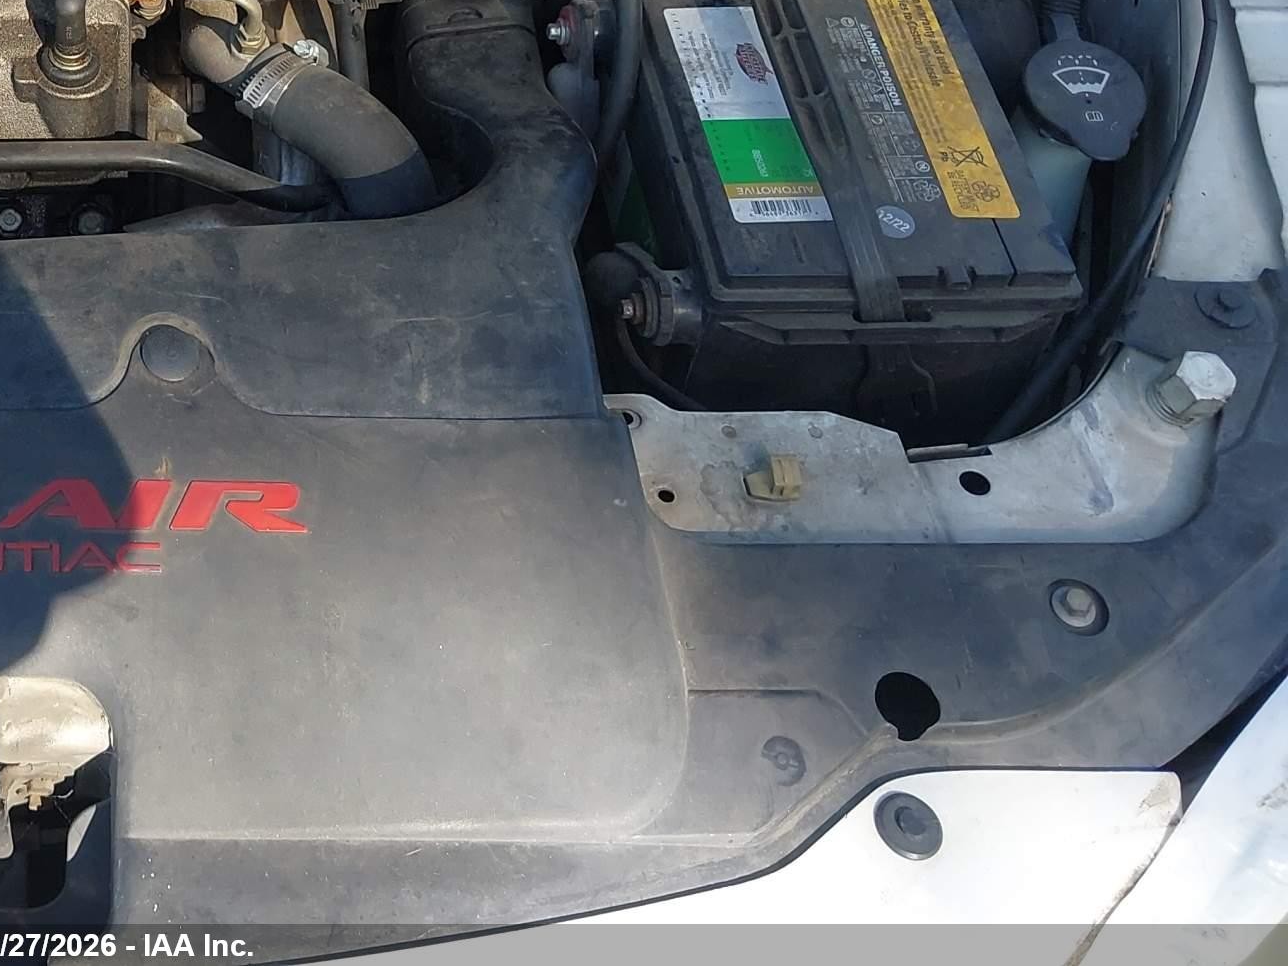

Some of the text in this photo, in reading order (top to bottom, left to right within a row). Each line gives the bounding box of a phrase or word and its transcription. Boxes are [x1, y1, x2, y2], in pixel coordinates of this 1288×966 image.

[864, 29, 902, 106] DANGER POISON
[907, 21, 922, 45] Costco
[916, 46, 941, 87] Wholesale
[916, 5, 935, 38] warranty
[930, 40, 944, 55] and
[937, 55, 955, 75] used
[735, 185, 814, 196] AUTOMOTIVE
[0, 478, 311, 534] AIR
